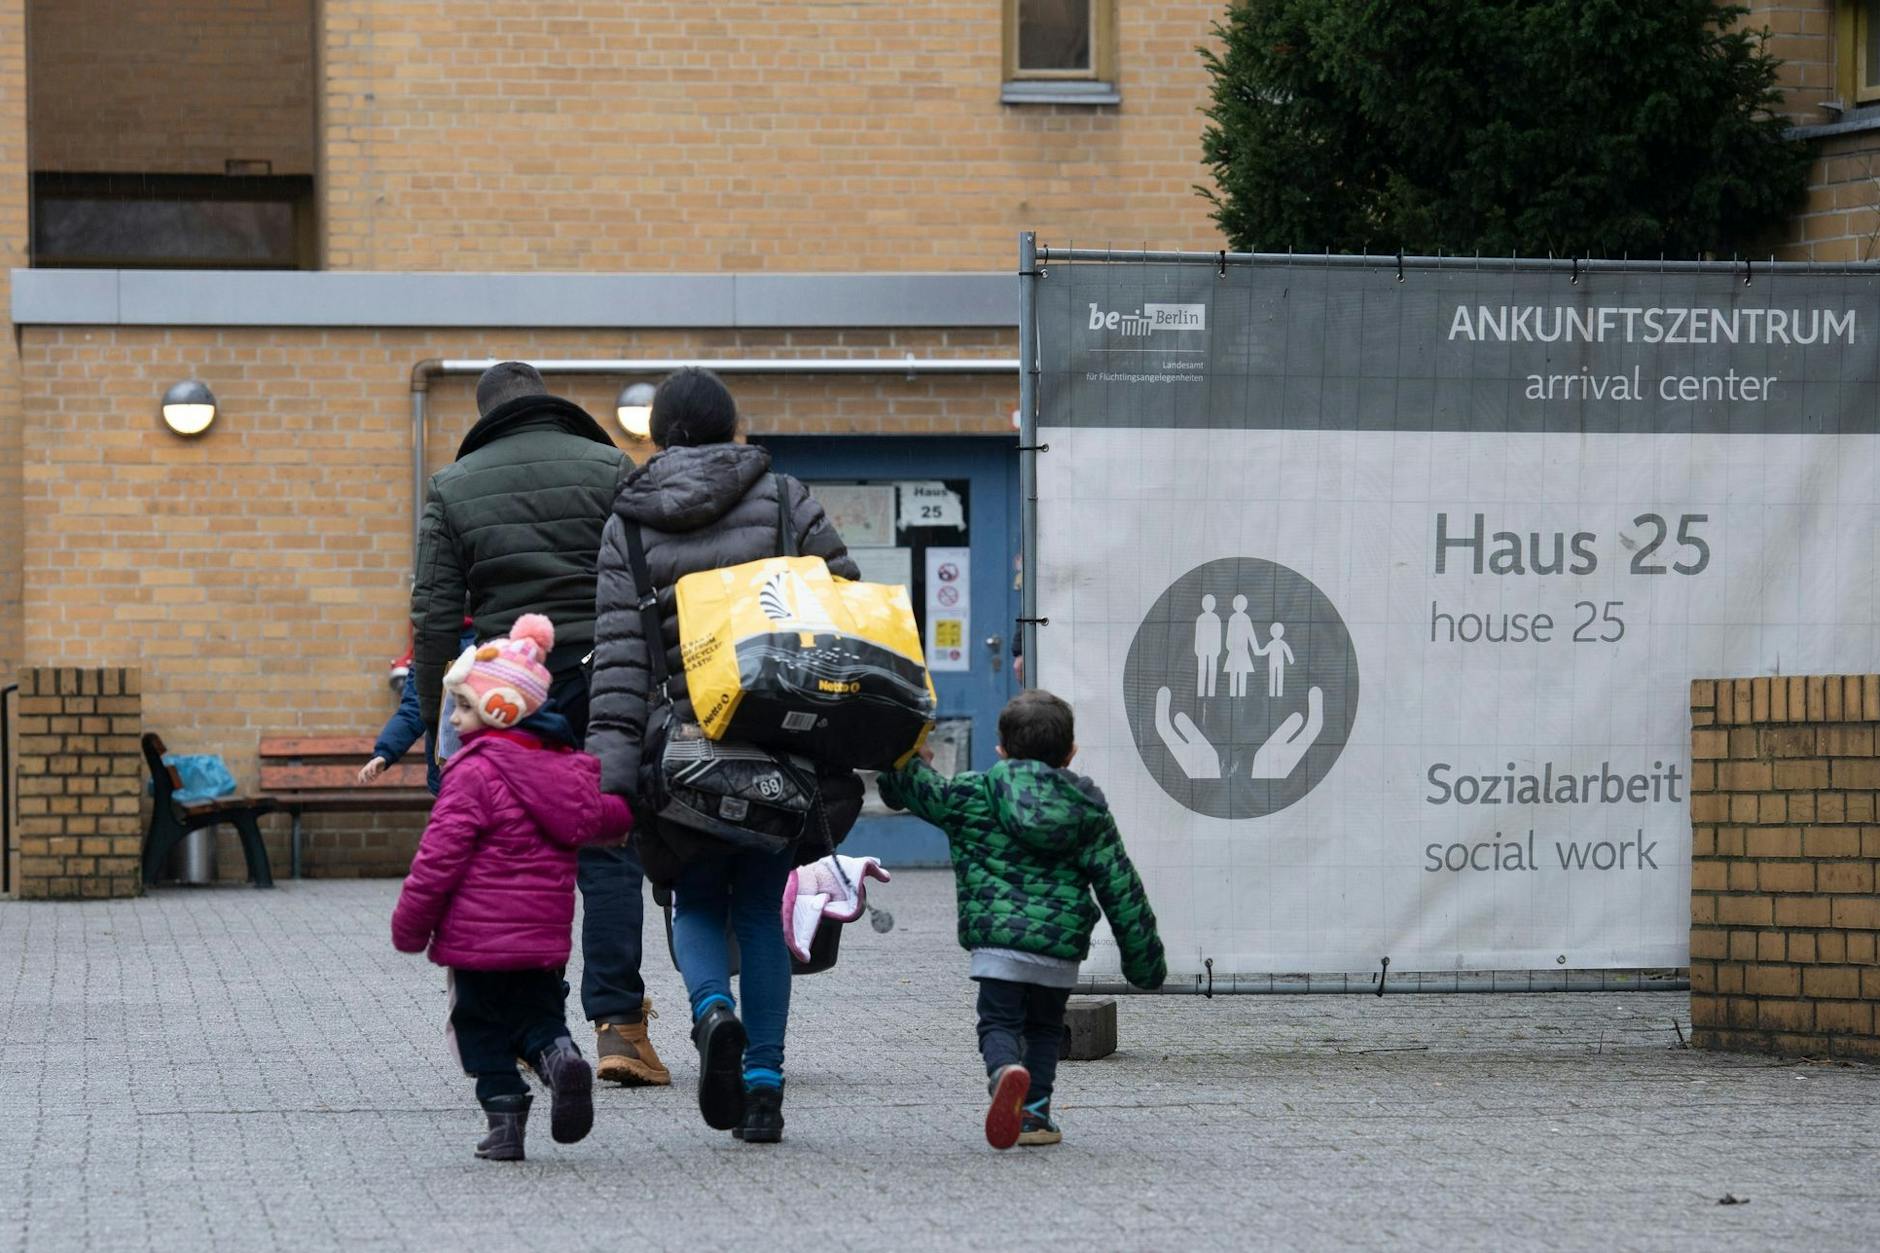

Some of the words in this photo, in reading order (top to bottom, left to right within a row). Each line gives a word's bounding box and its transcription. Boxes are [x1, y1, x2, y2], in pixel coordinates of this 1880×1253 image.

[1089, 303, 1120, 330] be
[1155, 309, 1200, 325] Berlin
[1448, 305, 1856, 345] ANKUNFTSZENTRUM
[1162, 360, 1204, 370] Landesamt
[1525, 365, 1641, 401] arrival
[1659, 368, 1778, 401] center
[914, 486, 948, 498] Haus
[920, 505, 943, 519] 25
[1434, 512, 1598, 576] Haus
[1629, 512, 1711, 576] 25
[1430, 600, 1555, 643] house
[1571, 600, 1625, 643] 25
[818, 679, 849, 693] Netto
[703, 702, 723, 727] Netto
[760, 778, 780, 796] 69
[1425, 761, 1684, 806] Sozialarbeit
[1424, 830, 1539, 873] social
[1555, 829, 1659, 871] work
